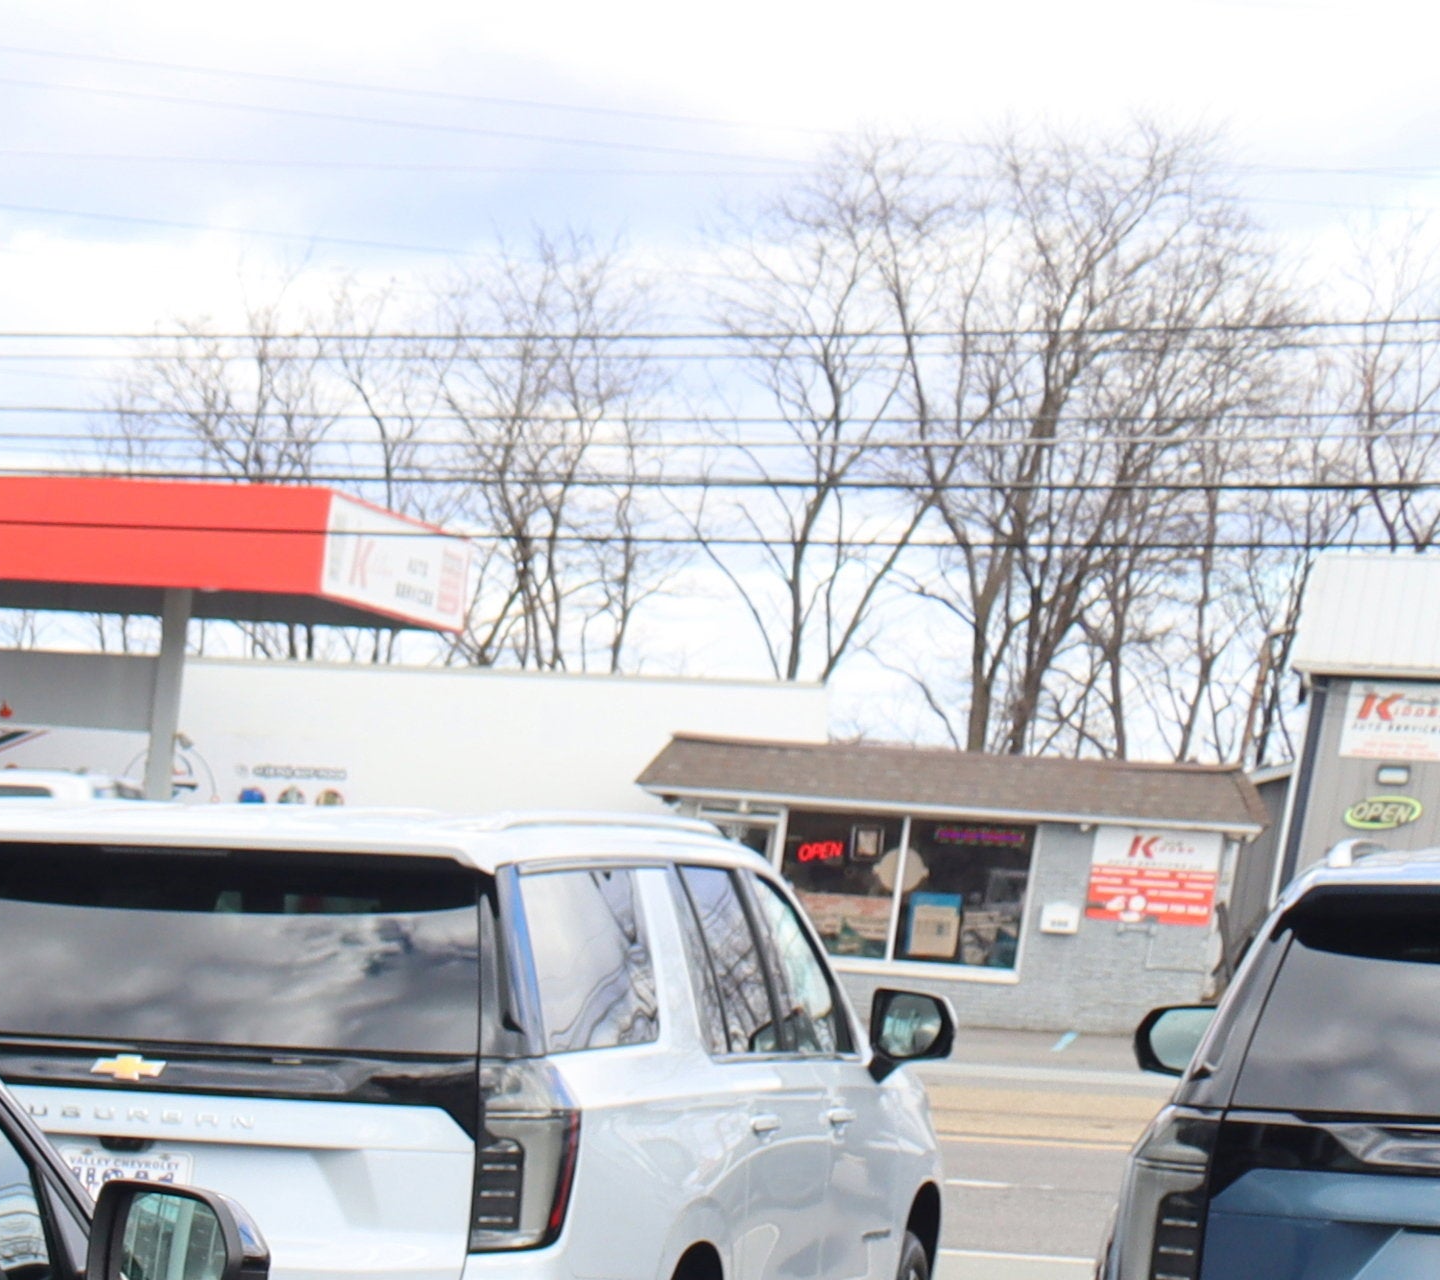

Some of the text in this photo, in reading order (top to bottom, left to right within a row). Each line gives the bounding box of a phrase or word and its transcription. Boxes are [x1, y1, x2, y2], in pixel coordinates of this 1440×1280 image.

[1352, 800, 1413, 824] OPEN
[797, 840, 843, 863] OPEN
[30, 1104, 256, 1131] UBURBAN
[69, 1155, 179, 1171] VALLEY CHEVROLET
